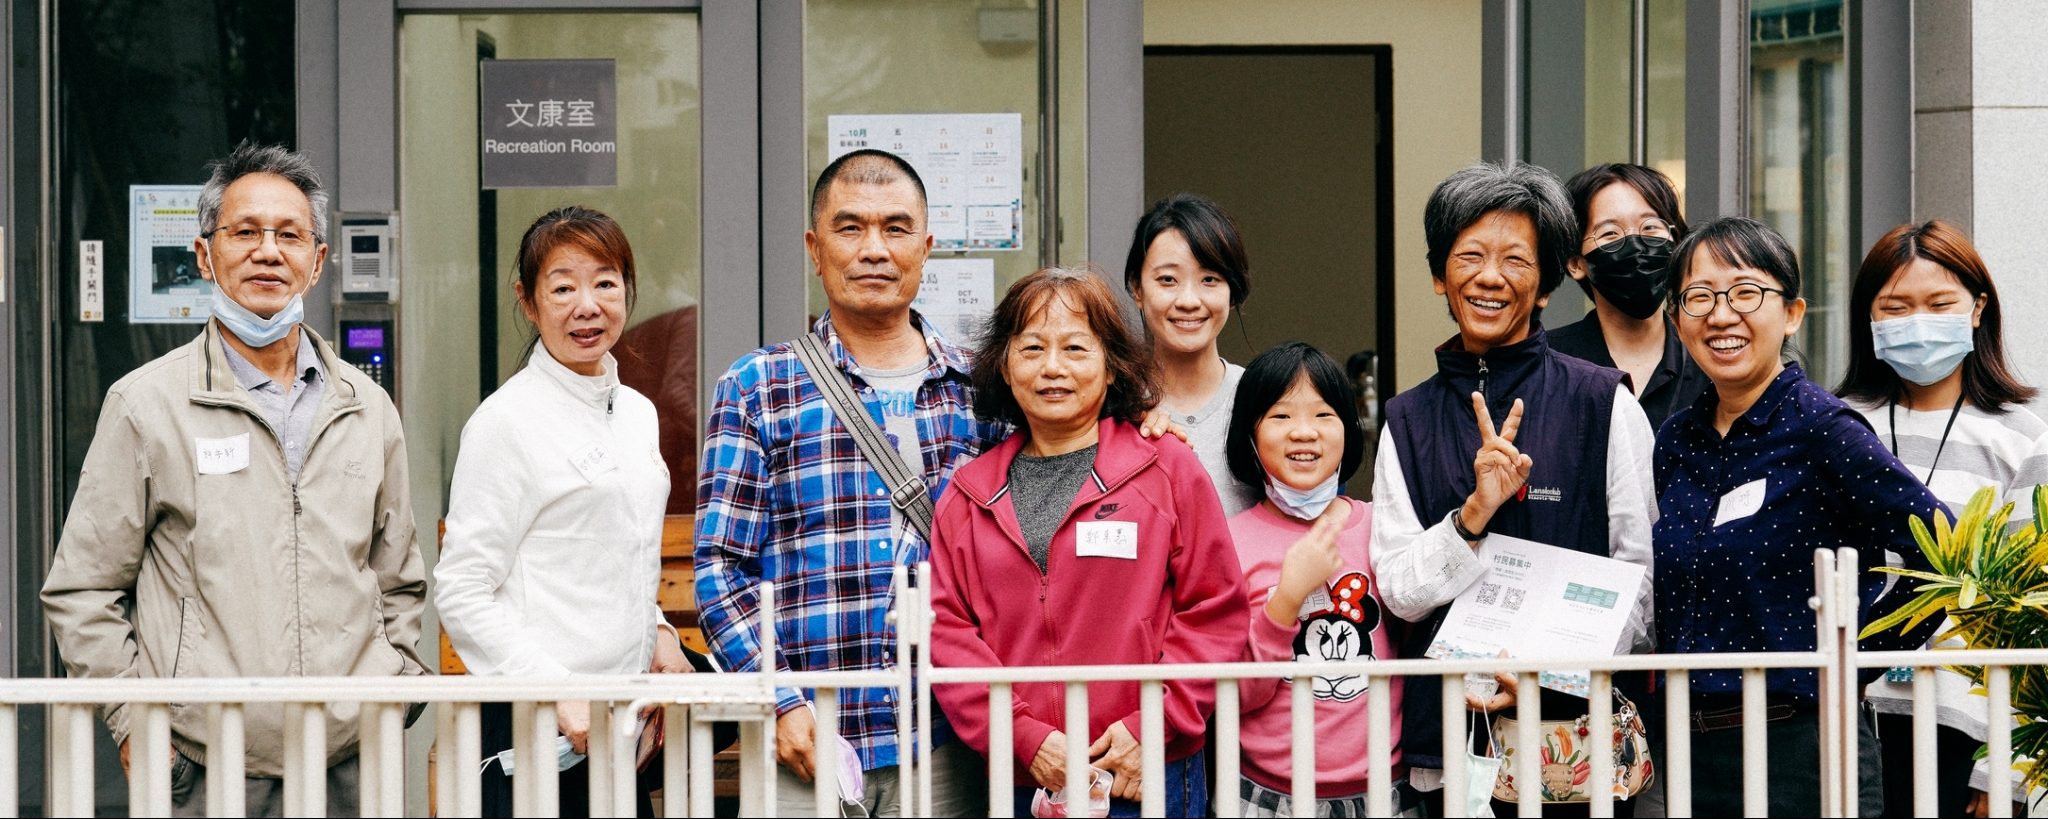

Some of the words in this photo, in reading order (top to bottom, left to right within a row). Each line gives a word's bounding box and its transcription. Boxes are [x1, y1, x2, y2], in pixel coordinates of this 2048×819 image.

[505, 98, 595, 128] 文康室
[485, 139, 567, 154] Recreation
[571, 139, 616, 153] Room
[1100, 503, 1120, 512] NIKE
